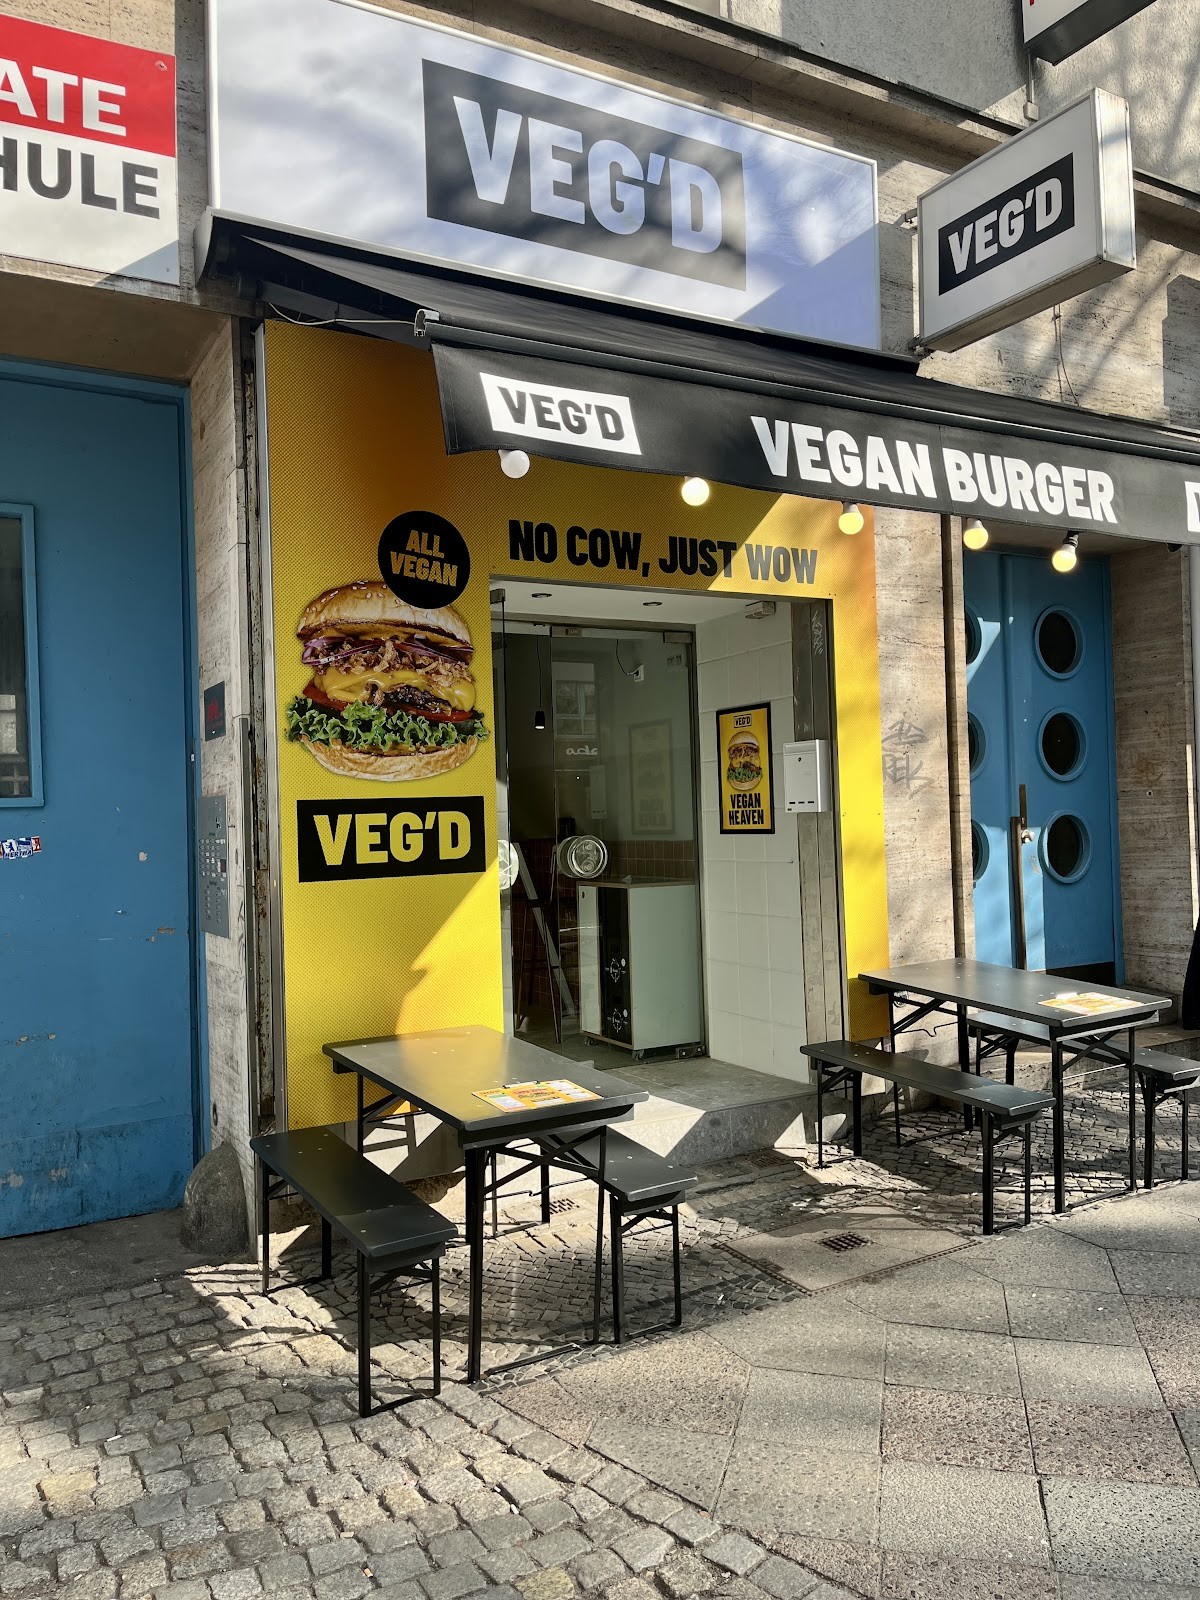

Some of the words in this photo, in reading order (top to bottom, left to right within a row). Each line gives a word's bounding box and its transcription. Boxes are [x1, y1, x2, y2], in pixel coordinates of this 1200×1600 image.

[0, 57, 127, 137] ATE
[452, 95, 723, 254] VEG'D
[948, 177, 1063, 275] VEG'D
[496, 385, 625, 442] VEG'D
[750, 415, 938, 499] VEGAN
[942, 447, 1119, 524] BURGER
[389, 550, 458, 587] VEGAN
[405, 529, 445, 559] ALL
[508, 519, 558, 564] NO
[566, 525, 650, 577] COW,
[658, 535, 737, 578] JUST
[744, 543, 818, 585] WOW
[735, 715, 751, 727] VEG'D
[728, 809, 765, 826] HEAVEN
[730, 792, 762, 809] VEGAN
[312, 810, 472, 866] VEG'D
